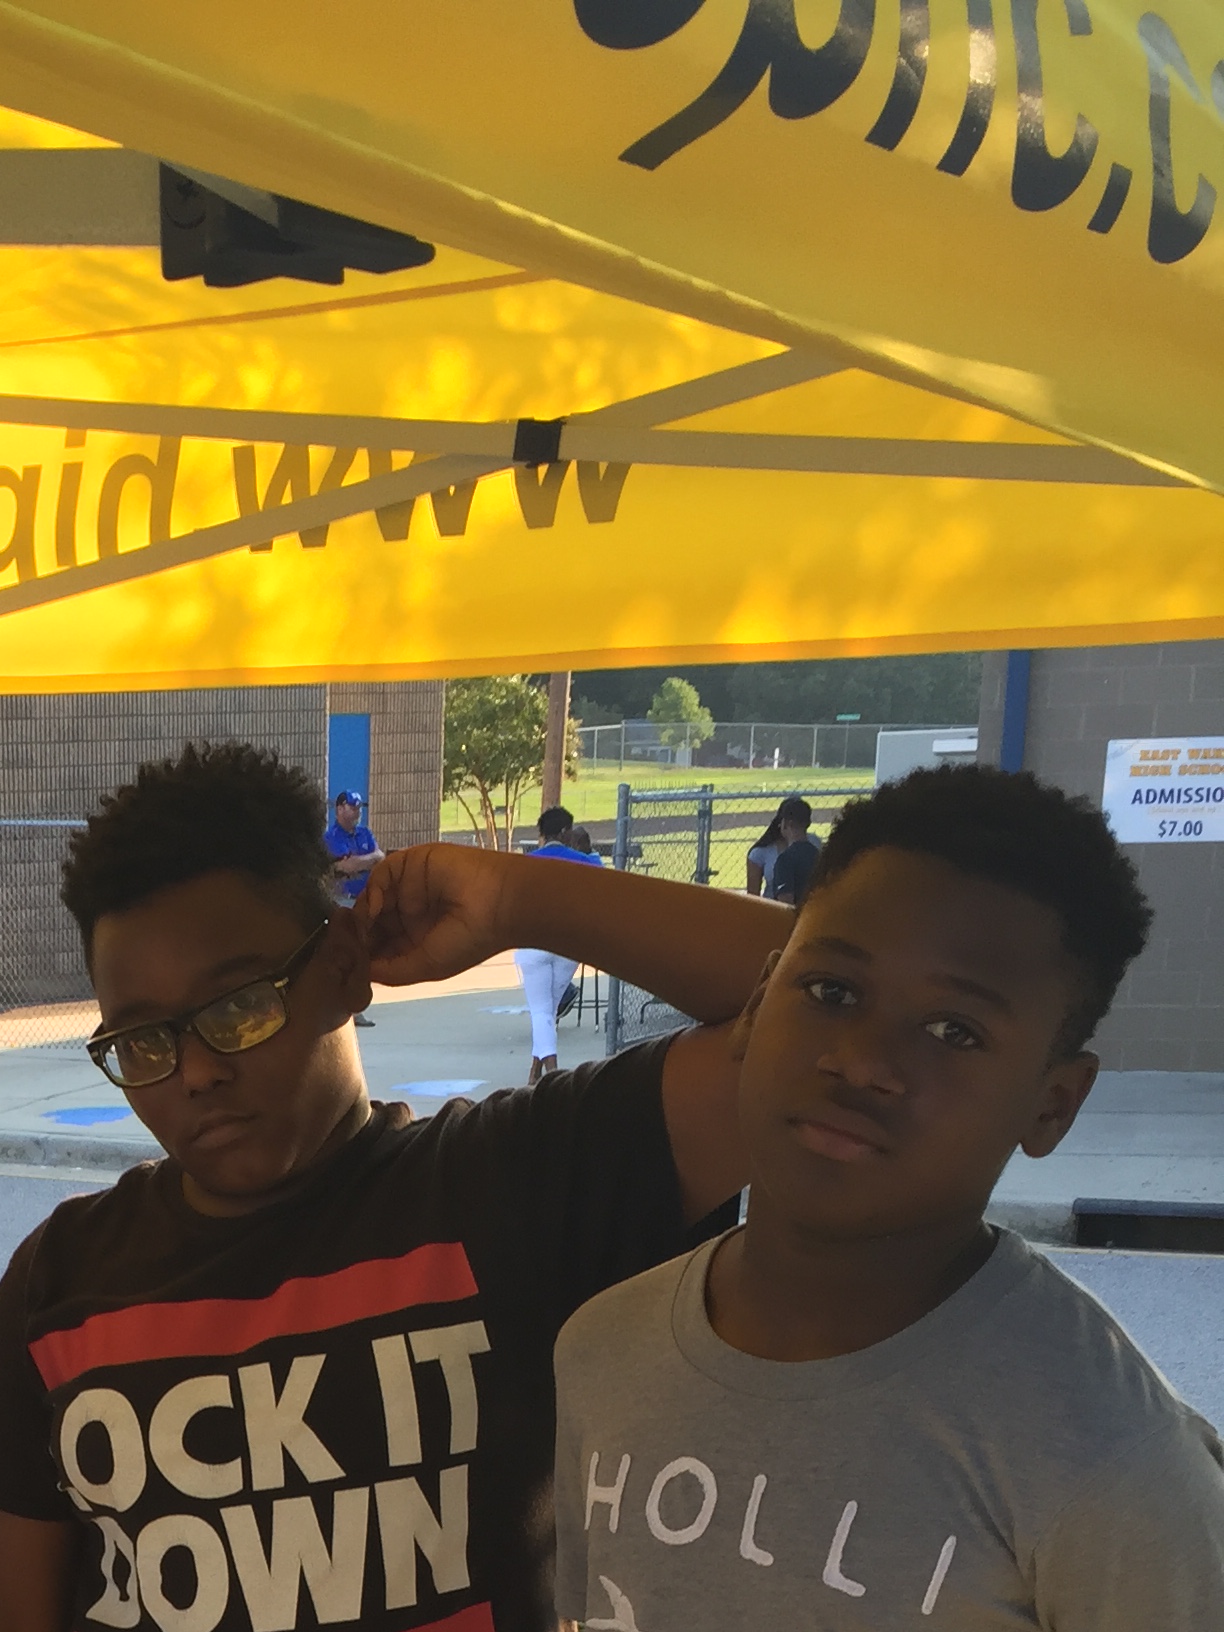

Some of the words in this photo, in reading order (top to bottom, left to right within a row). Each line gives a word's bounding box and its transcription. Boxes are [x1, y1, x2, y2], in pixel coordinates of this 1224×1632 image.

[1158, 820, 1203, 838] $7.00
[57, 1353, 346, 1512] OCK
[371, 1320, 491, 1467] IT
[584, 1451, 957, 1615] HOLLI
